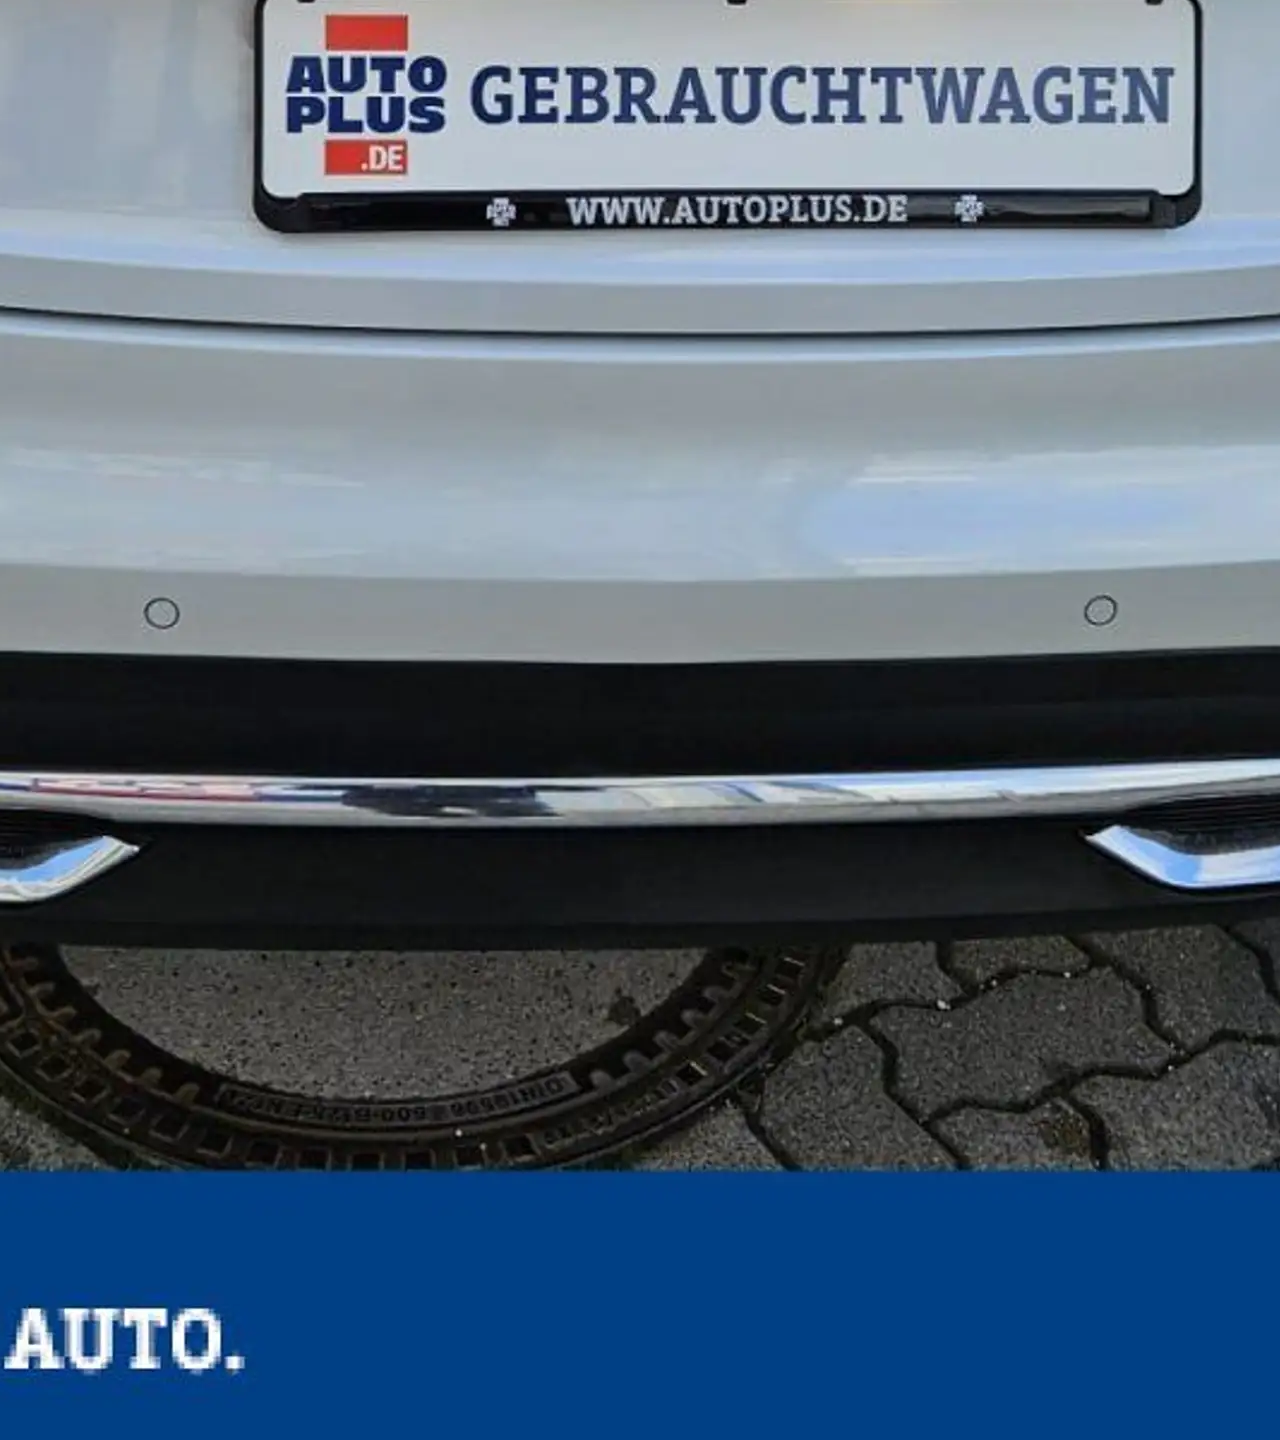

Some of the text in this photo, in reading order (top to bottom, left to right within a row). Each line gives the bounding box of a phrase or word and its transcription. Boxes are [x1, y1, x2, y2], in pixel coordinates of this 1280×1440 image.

[286, 54, 447, 94] AUTO
[470, 64, 1176, 125] GEBRAUCHTWAGEN
[286, 95, 447, 135] PLUS
[361, 144, 404, 173] .DE
[565, 194, 910, 226] WWW.AUTOPLUS.DE
